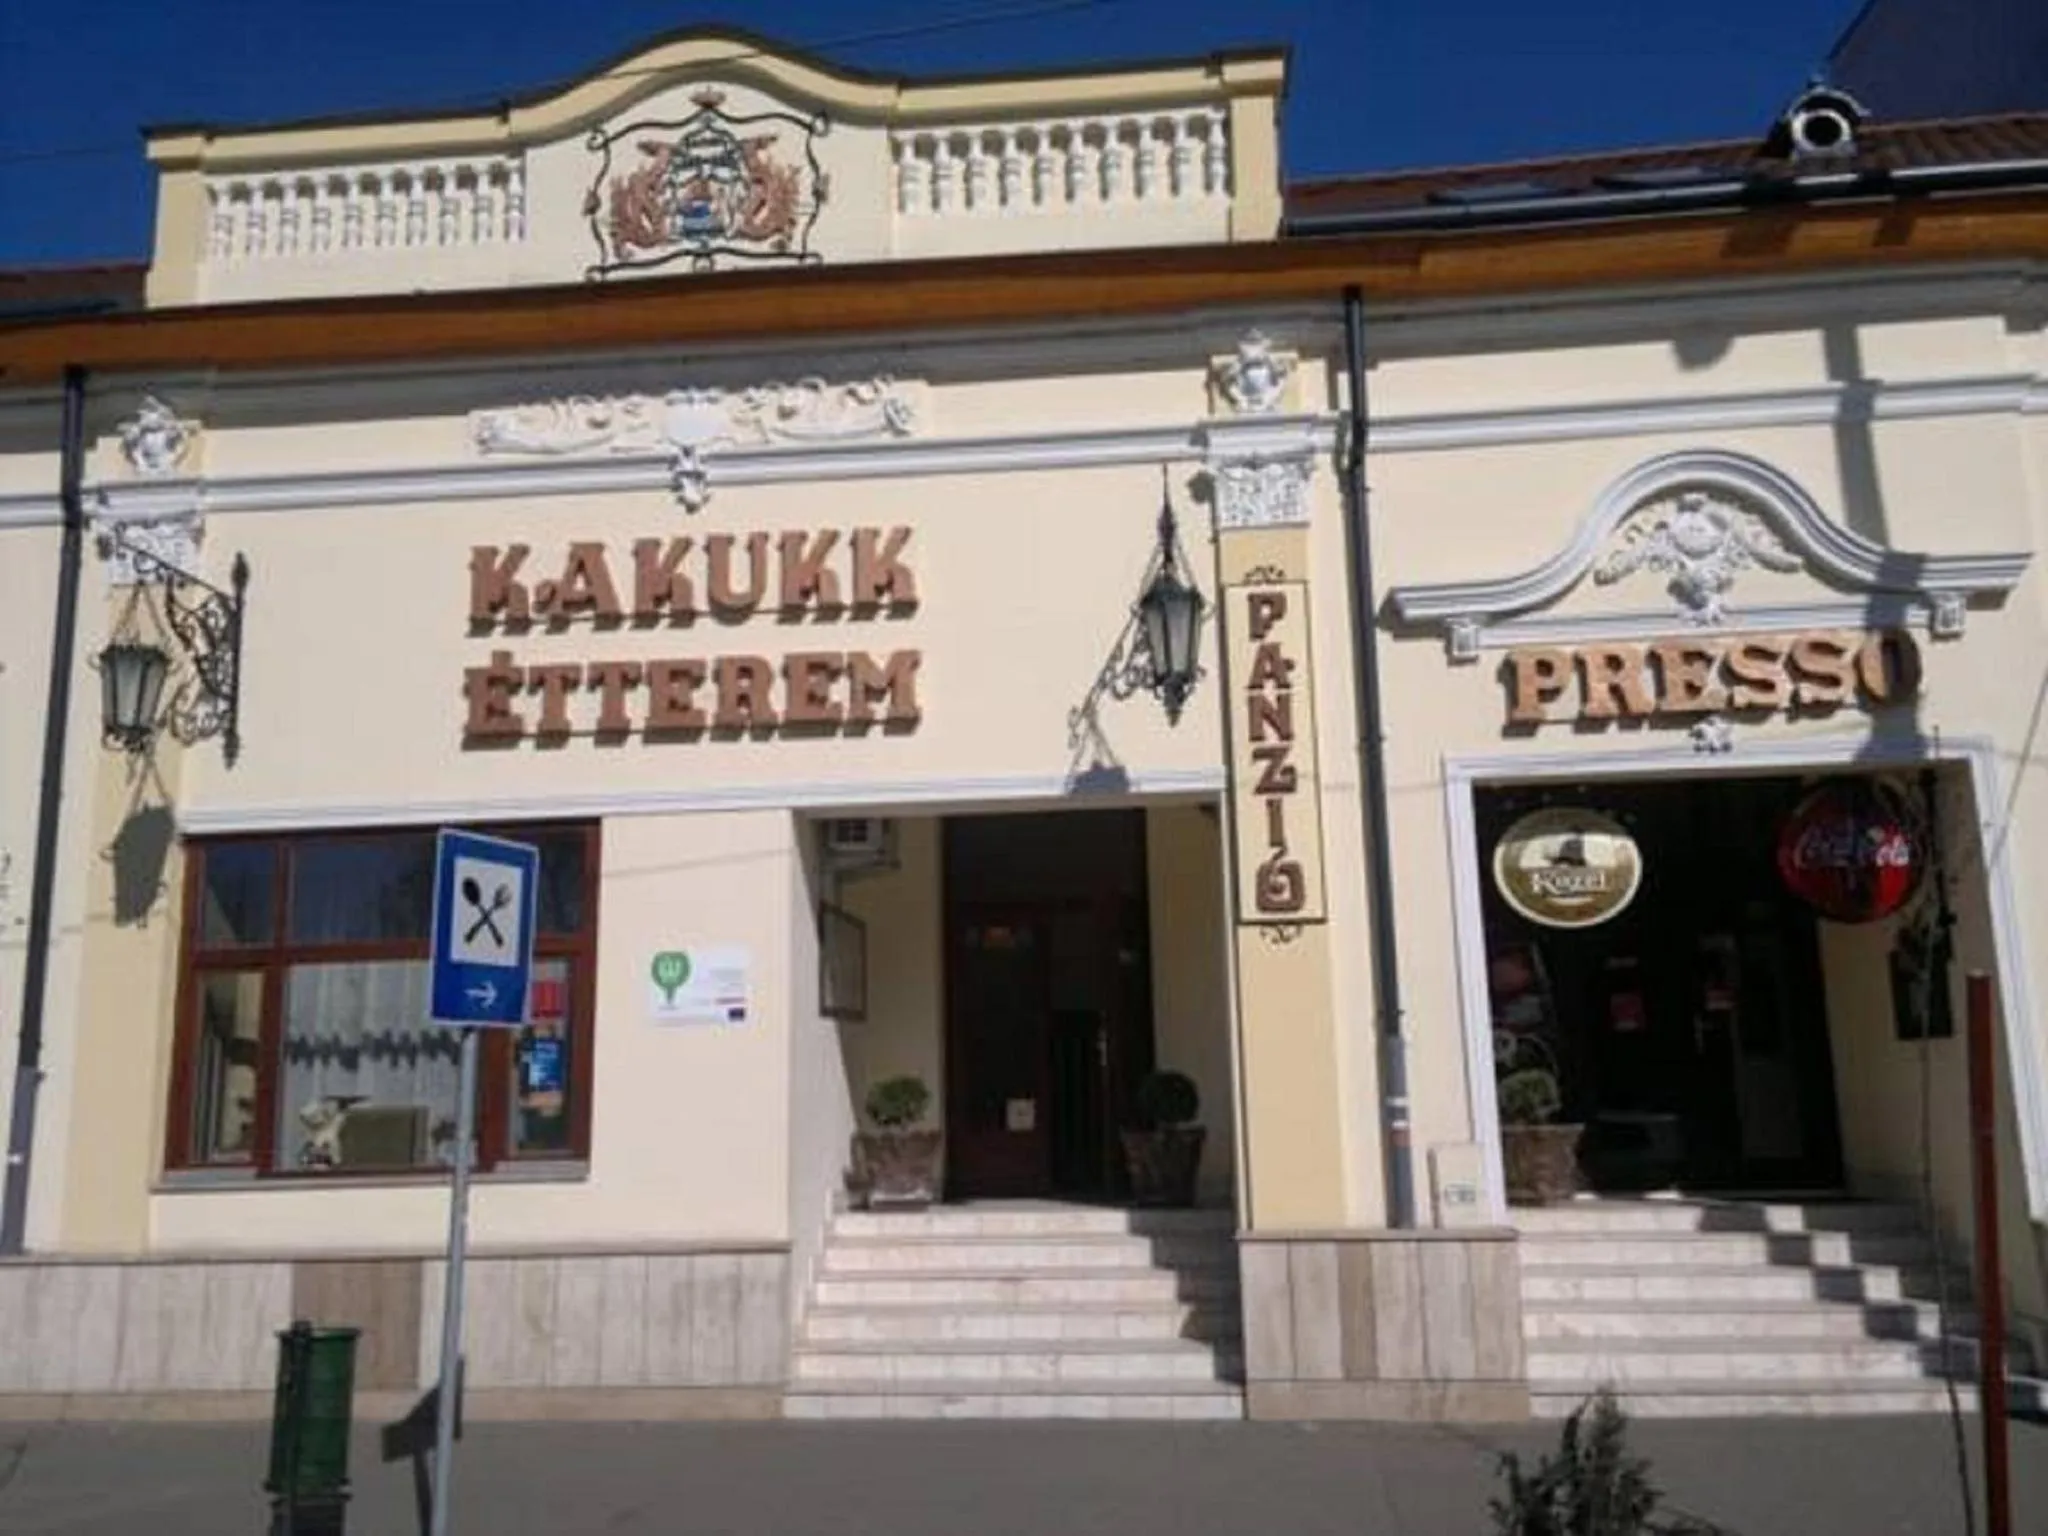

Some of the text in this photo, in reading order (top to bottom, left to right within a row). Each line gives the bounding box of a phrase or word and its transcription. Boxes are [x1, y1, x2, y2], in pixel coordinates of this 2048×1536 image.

[469, 526, 917, 620] KAKUKK
[464, 649, 922, 736] ÉTTEREM
[1503, 629, 1920, 722] PRESSO
[1245, 591, 1306, 913] PANZIÓ
[1793, 822, 1911, 871] CCola
